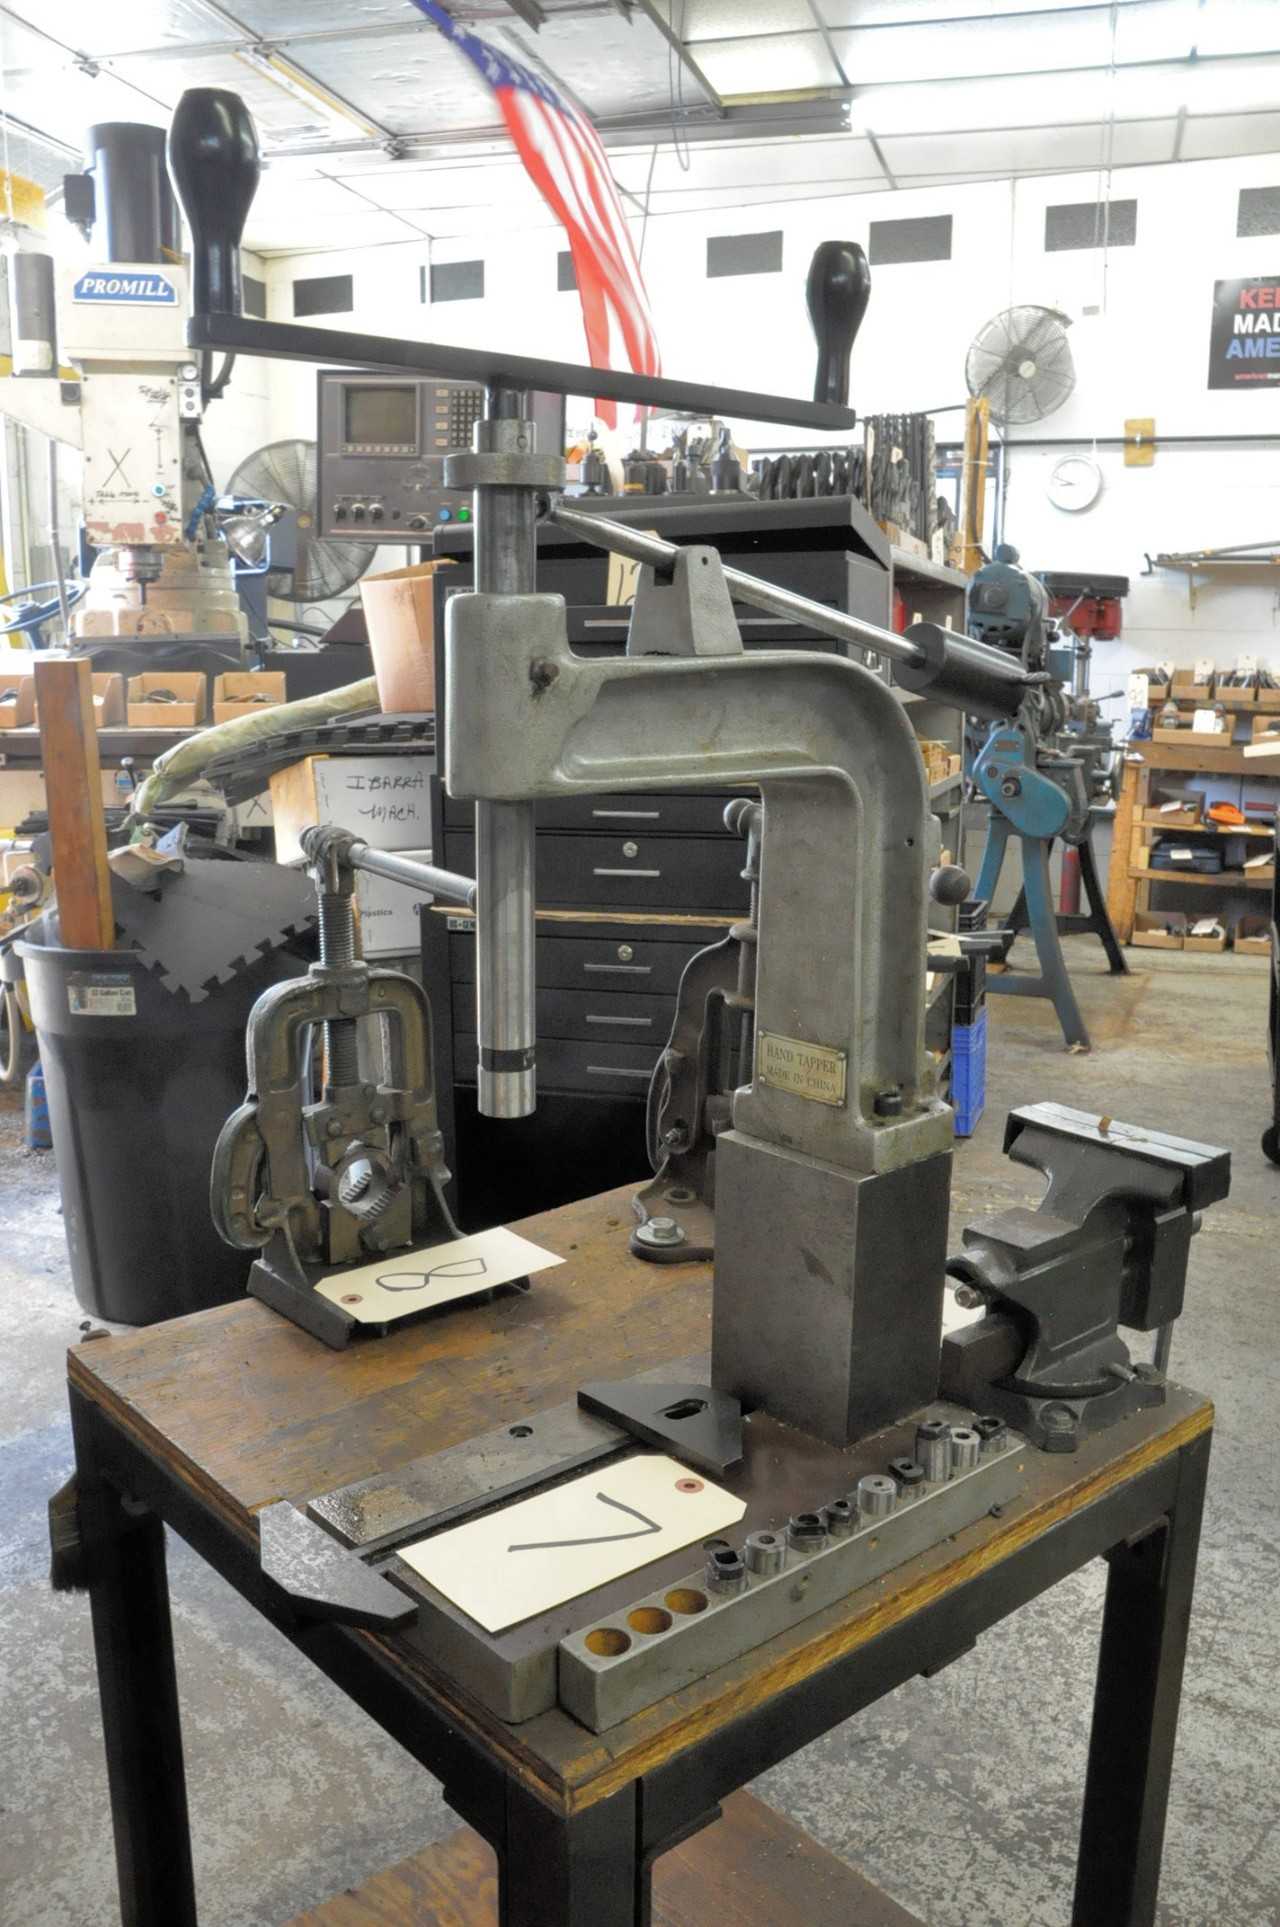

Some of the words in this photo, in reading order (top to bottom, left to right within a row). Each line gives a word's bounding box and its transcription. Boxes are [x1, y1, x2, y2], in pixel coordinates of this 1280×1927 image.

[81, 278, 169, 296] PROMILL
[767, 1043, 793, 1061] HAND
[797, 1052, 837, 1074] TAPPER
[766, 1064, 790, 1080] MADE
[791, 1070, 802, 1085] IN
[804, 1076, 837, 1095] CHINA
[376, 1257, 487, 1292] 8
[507, 1492, 662, 1552] 7
